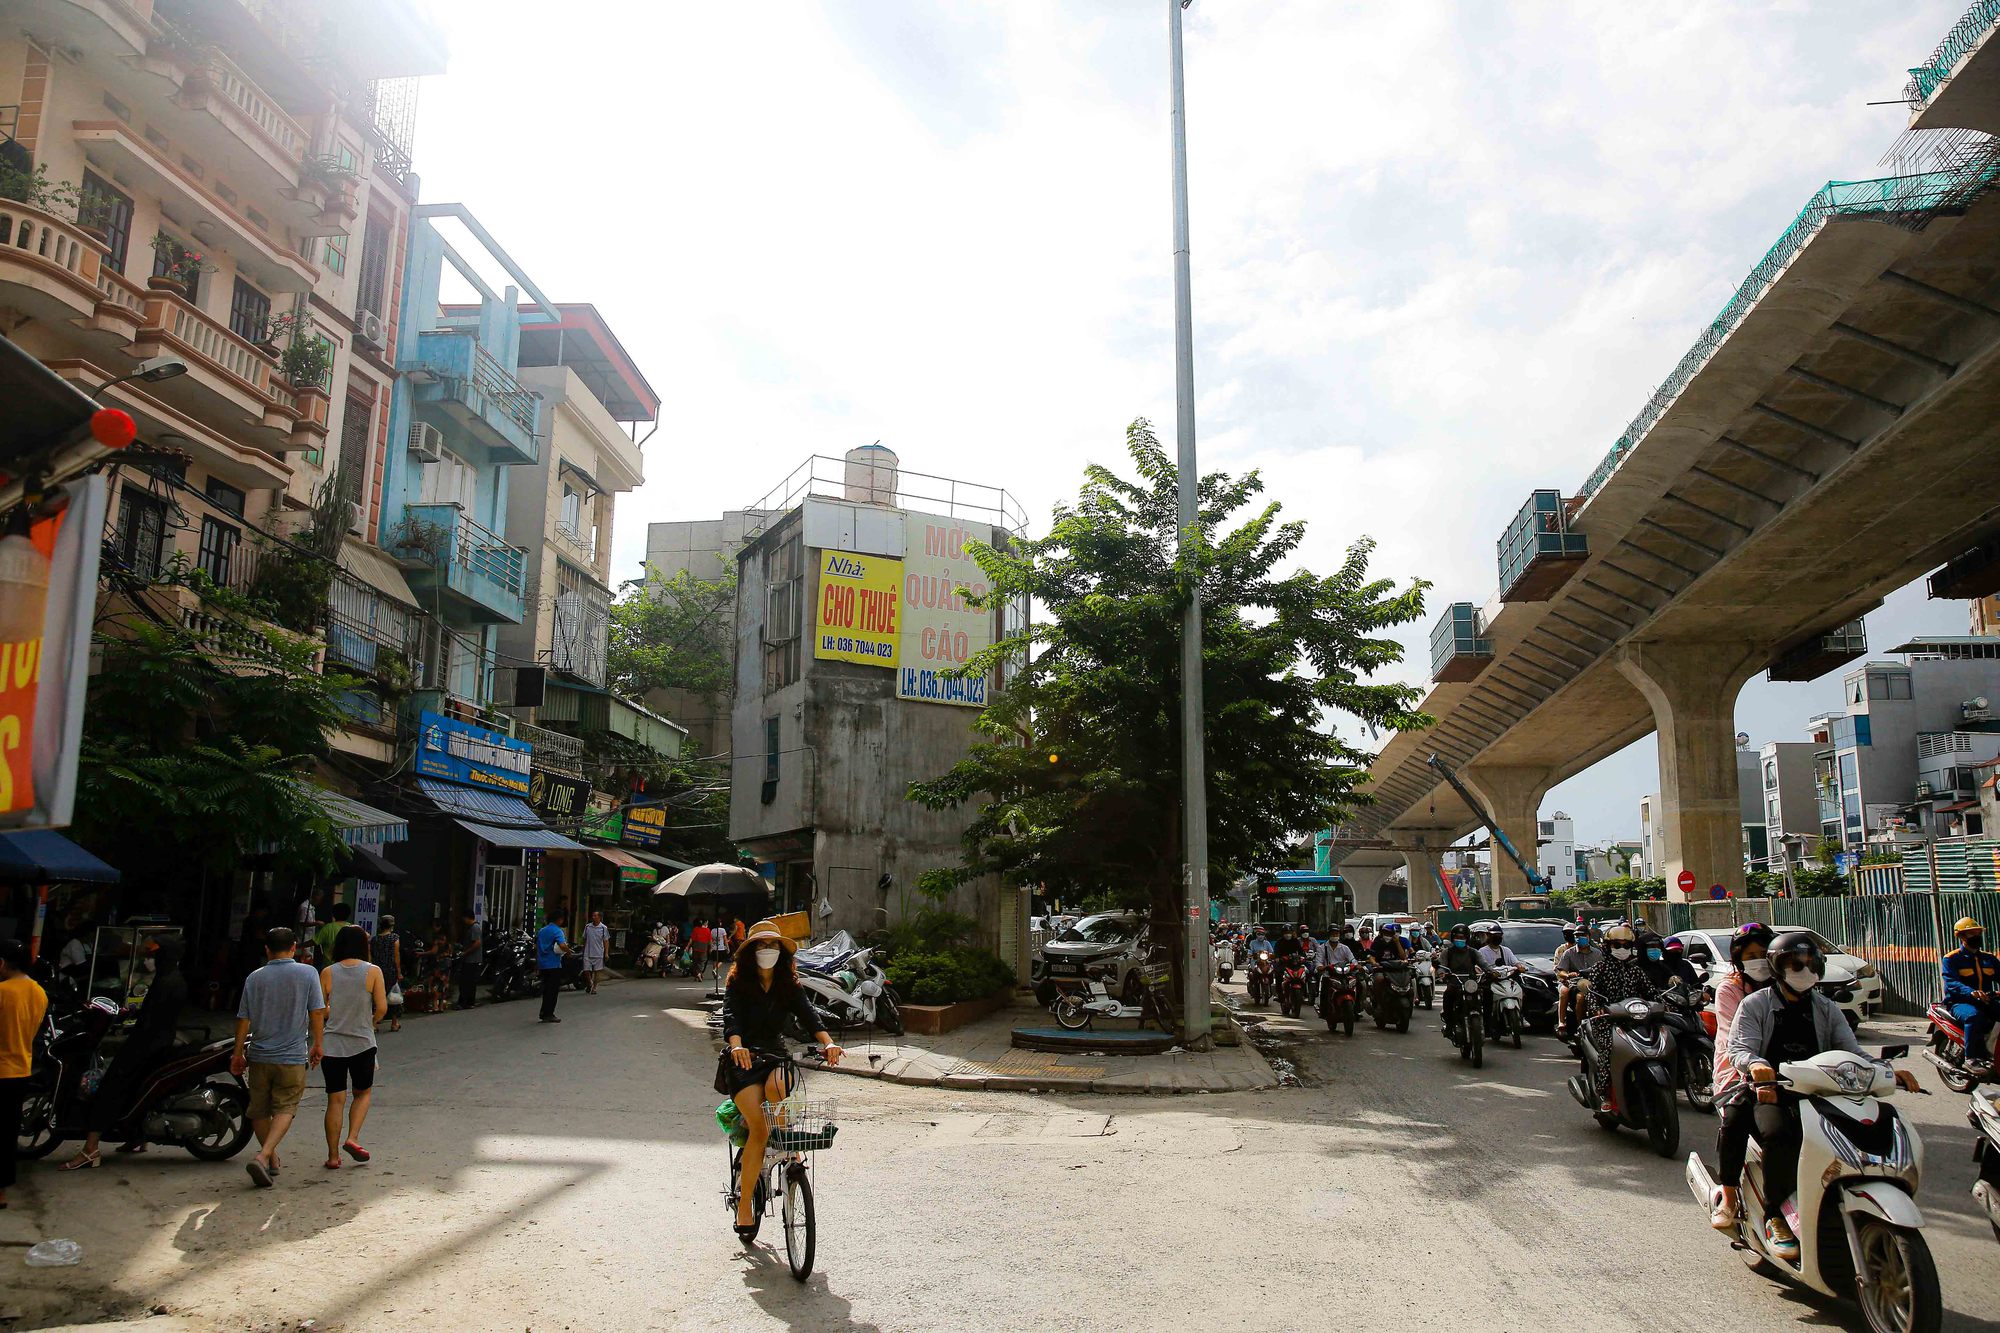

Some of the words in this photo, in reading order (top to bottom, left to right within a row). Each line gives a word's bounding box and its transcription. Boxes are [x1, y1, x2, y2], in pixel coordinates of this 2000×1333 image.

[823, 583, 856, 629] CHO
[859, 584, 897, 635] THUÊ
[822, 636, 835, 651] LH:
[837, 637, 853, 652] 036
[855, 639, 875, 655] 7044
[877, 642, 893, 658] 023
[921, 622, 969, 664] CÁO
[901, 667, 917, 697] LH:
[547, 783, 575, 813] LONG
